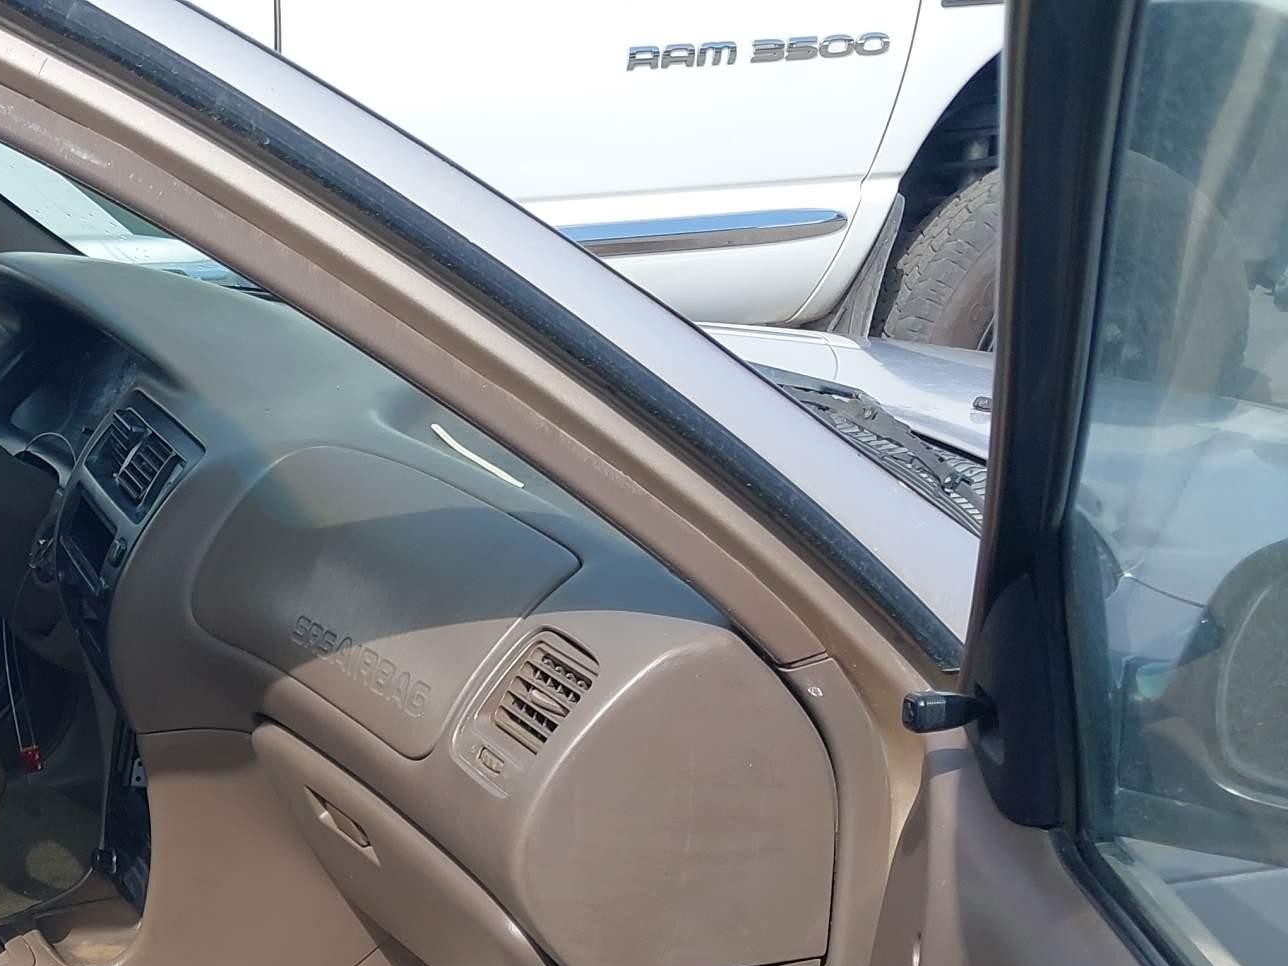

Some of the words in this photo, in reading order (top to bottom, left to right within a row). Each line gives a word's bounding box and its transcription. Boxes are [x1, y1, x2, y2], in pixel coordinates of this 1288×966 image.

[626, 41, 737, 72] RAM
[750, 32, 890, 63] 3500
[334, 636, 432, 719] AIRBAG
